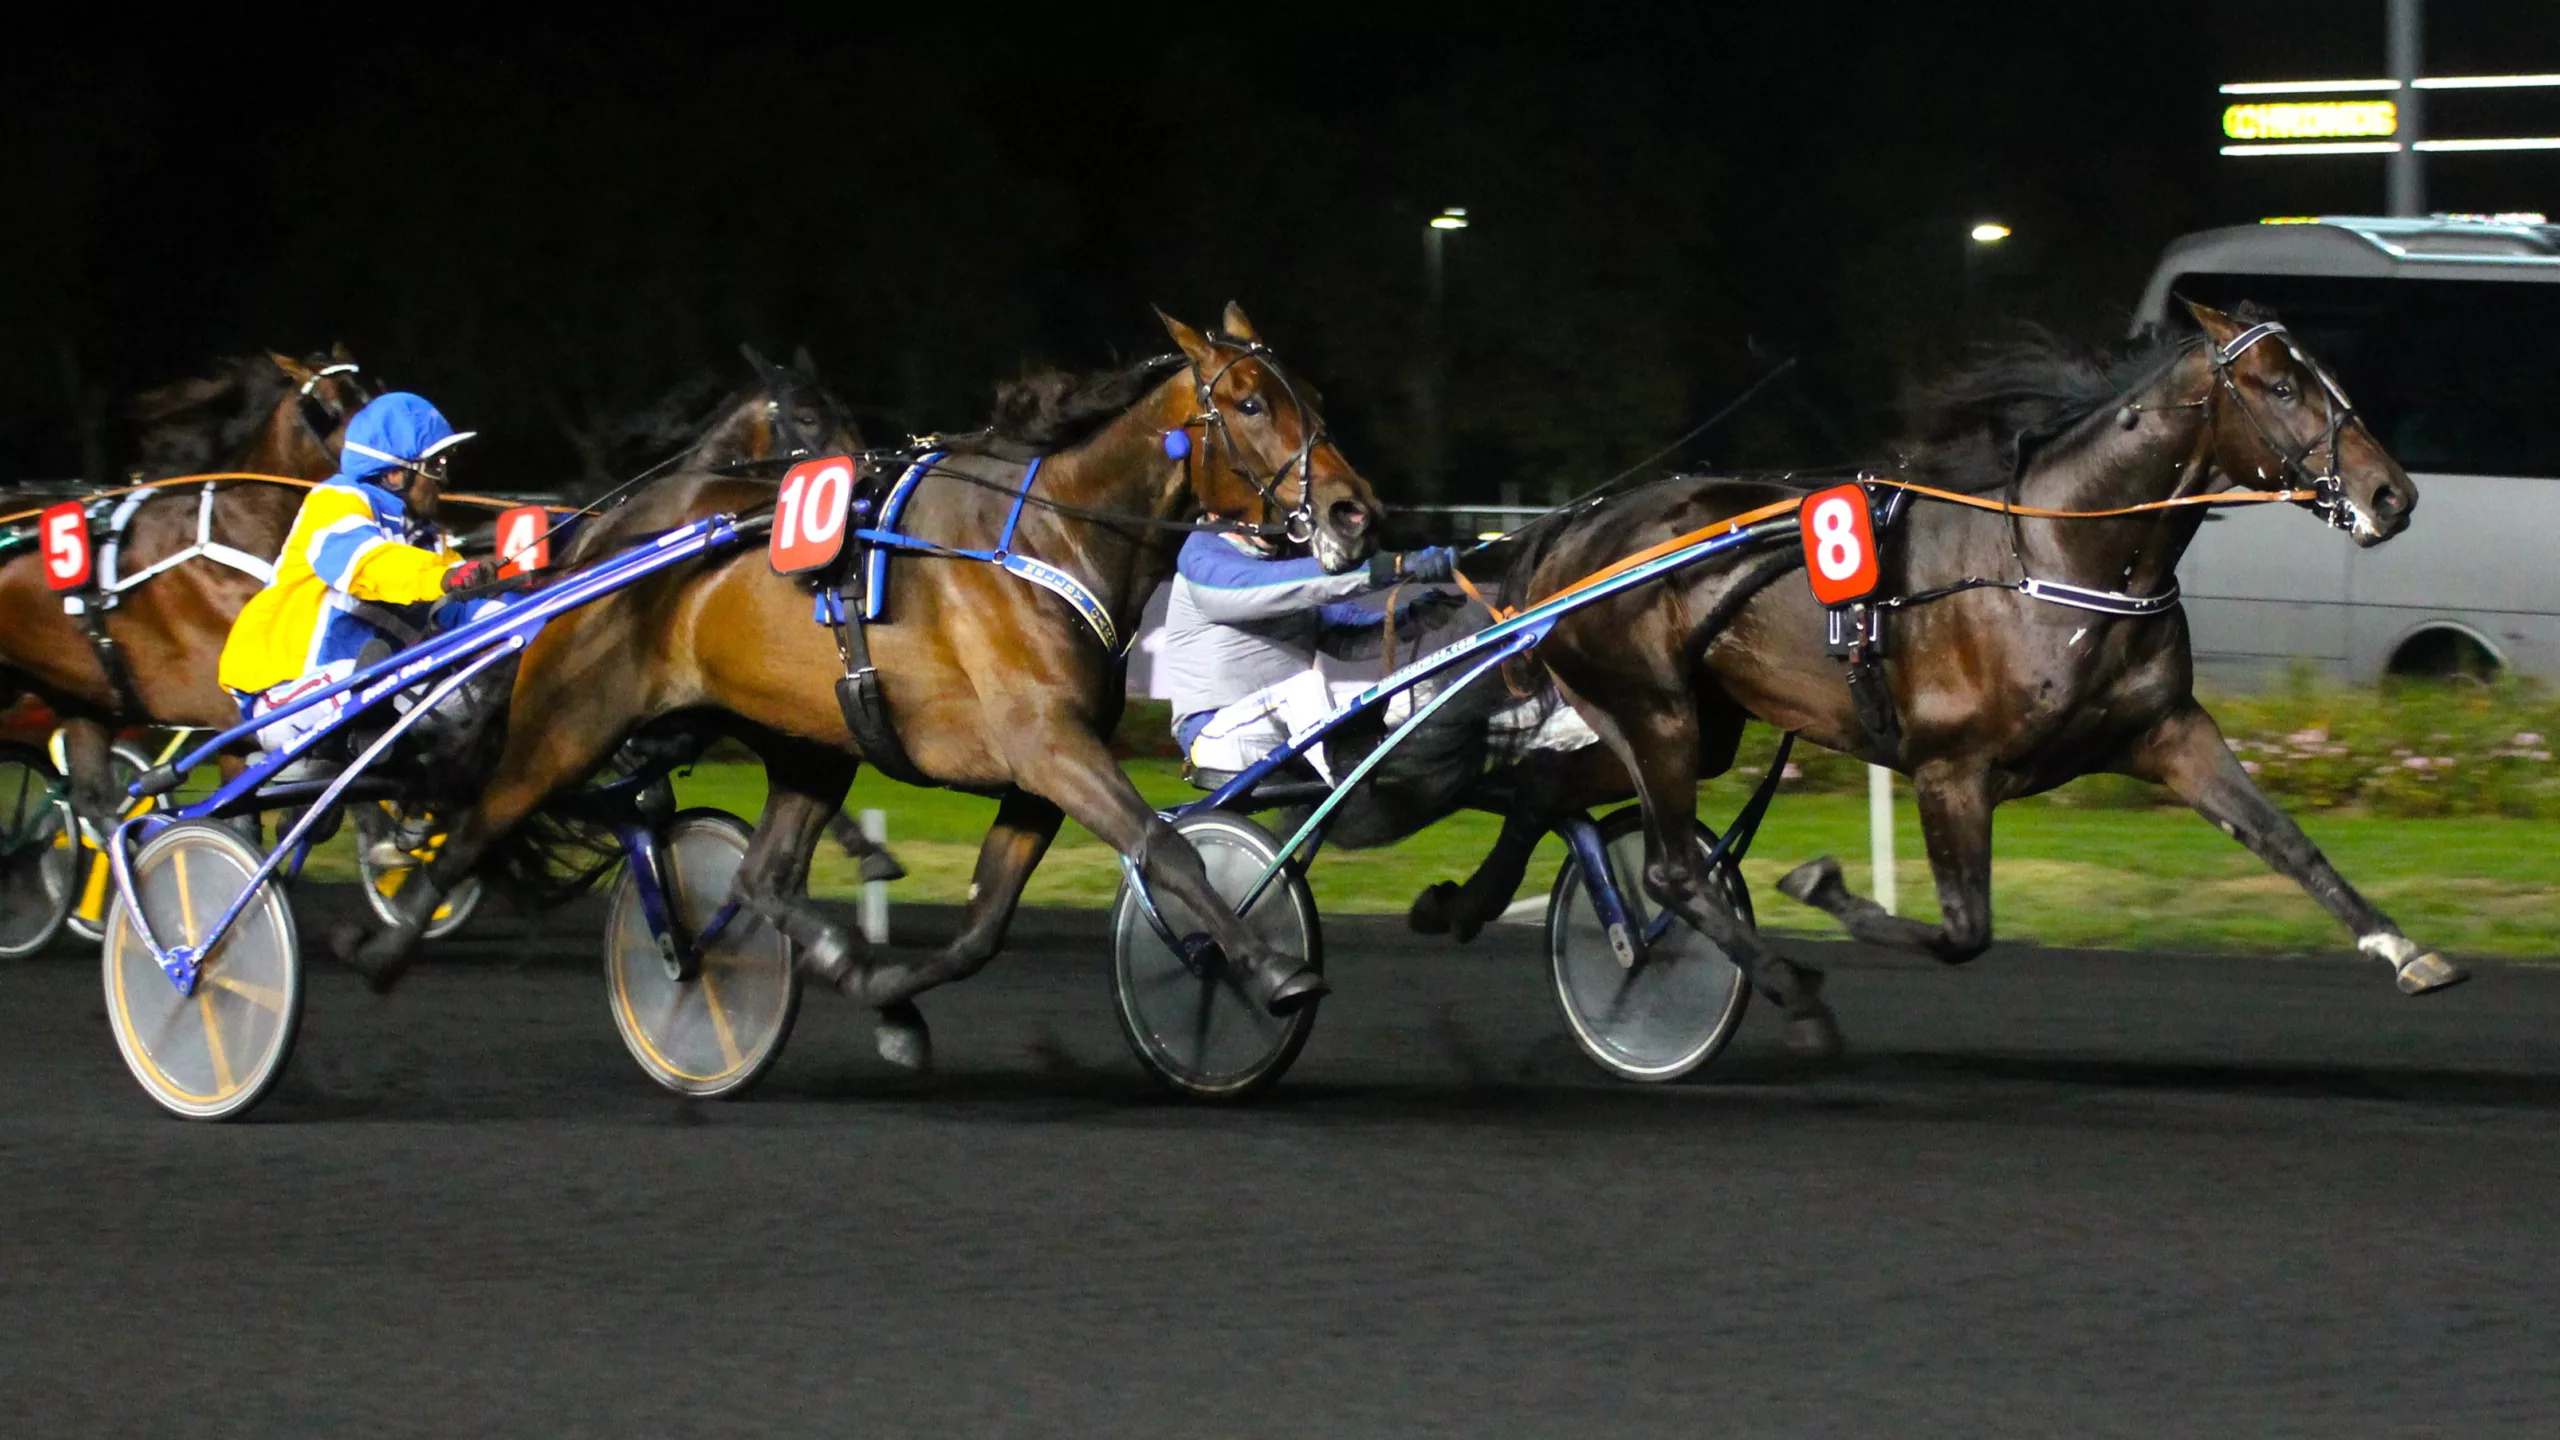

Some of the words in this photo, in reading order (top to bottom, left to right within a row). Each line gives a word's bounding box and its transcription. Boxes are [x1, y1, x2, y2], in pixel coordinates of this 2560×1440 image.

[502, 513, 538, 571] 4
[780, 466, 850, 549] 10
[1813, 497, 1862, 581] 8
[49, 513, 84, 579] 5
